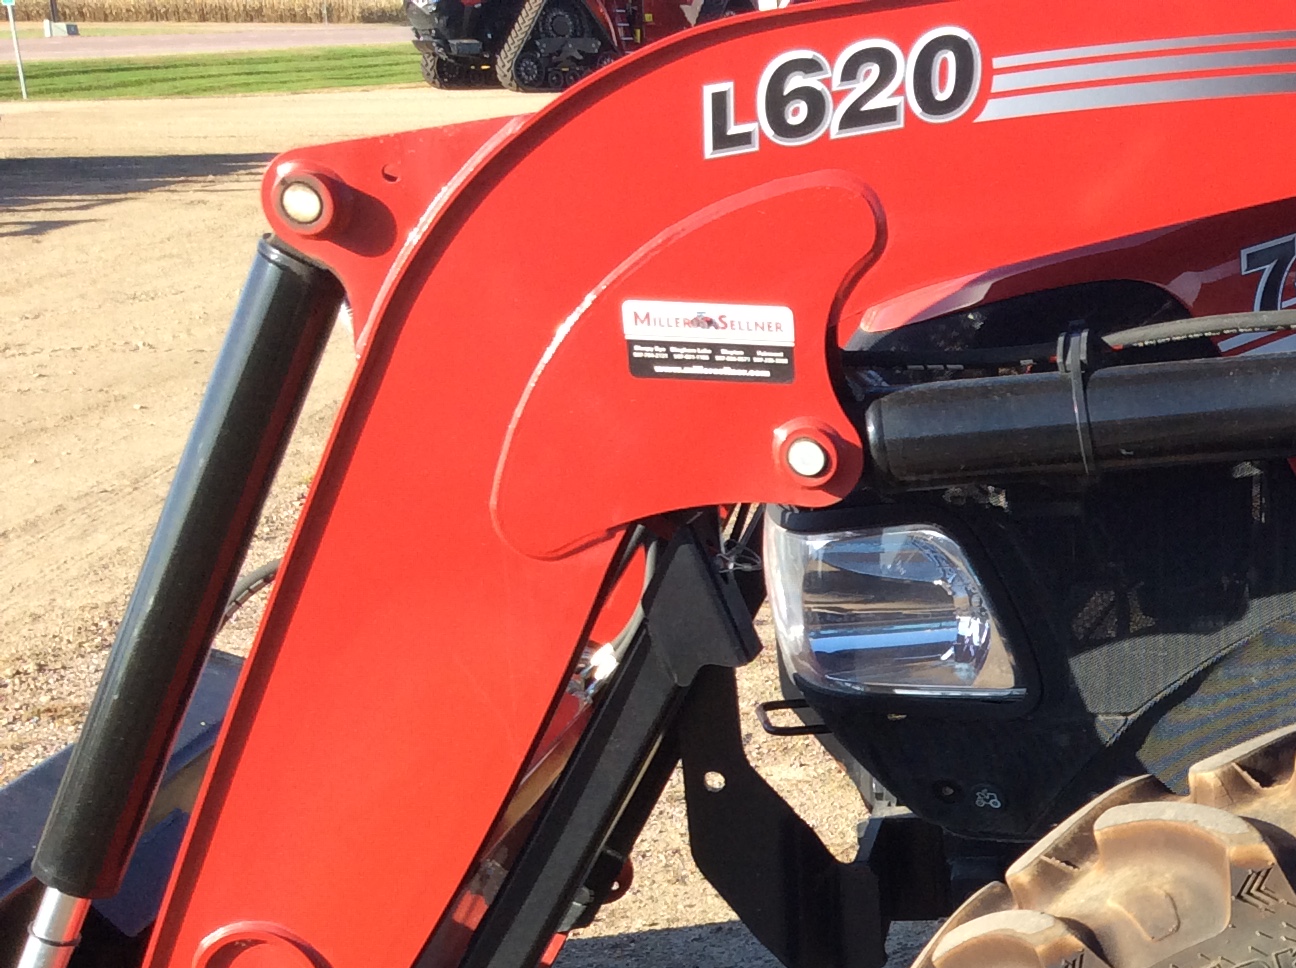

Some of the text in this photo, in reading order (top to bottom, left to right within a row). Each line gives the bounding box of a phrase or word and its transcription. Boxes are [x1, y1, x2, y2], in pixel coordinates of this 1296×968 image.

[702, 25, 982, 160] L620
[632, 310, 784, 333] MILLER SELLNER
